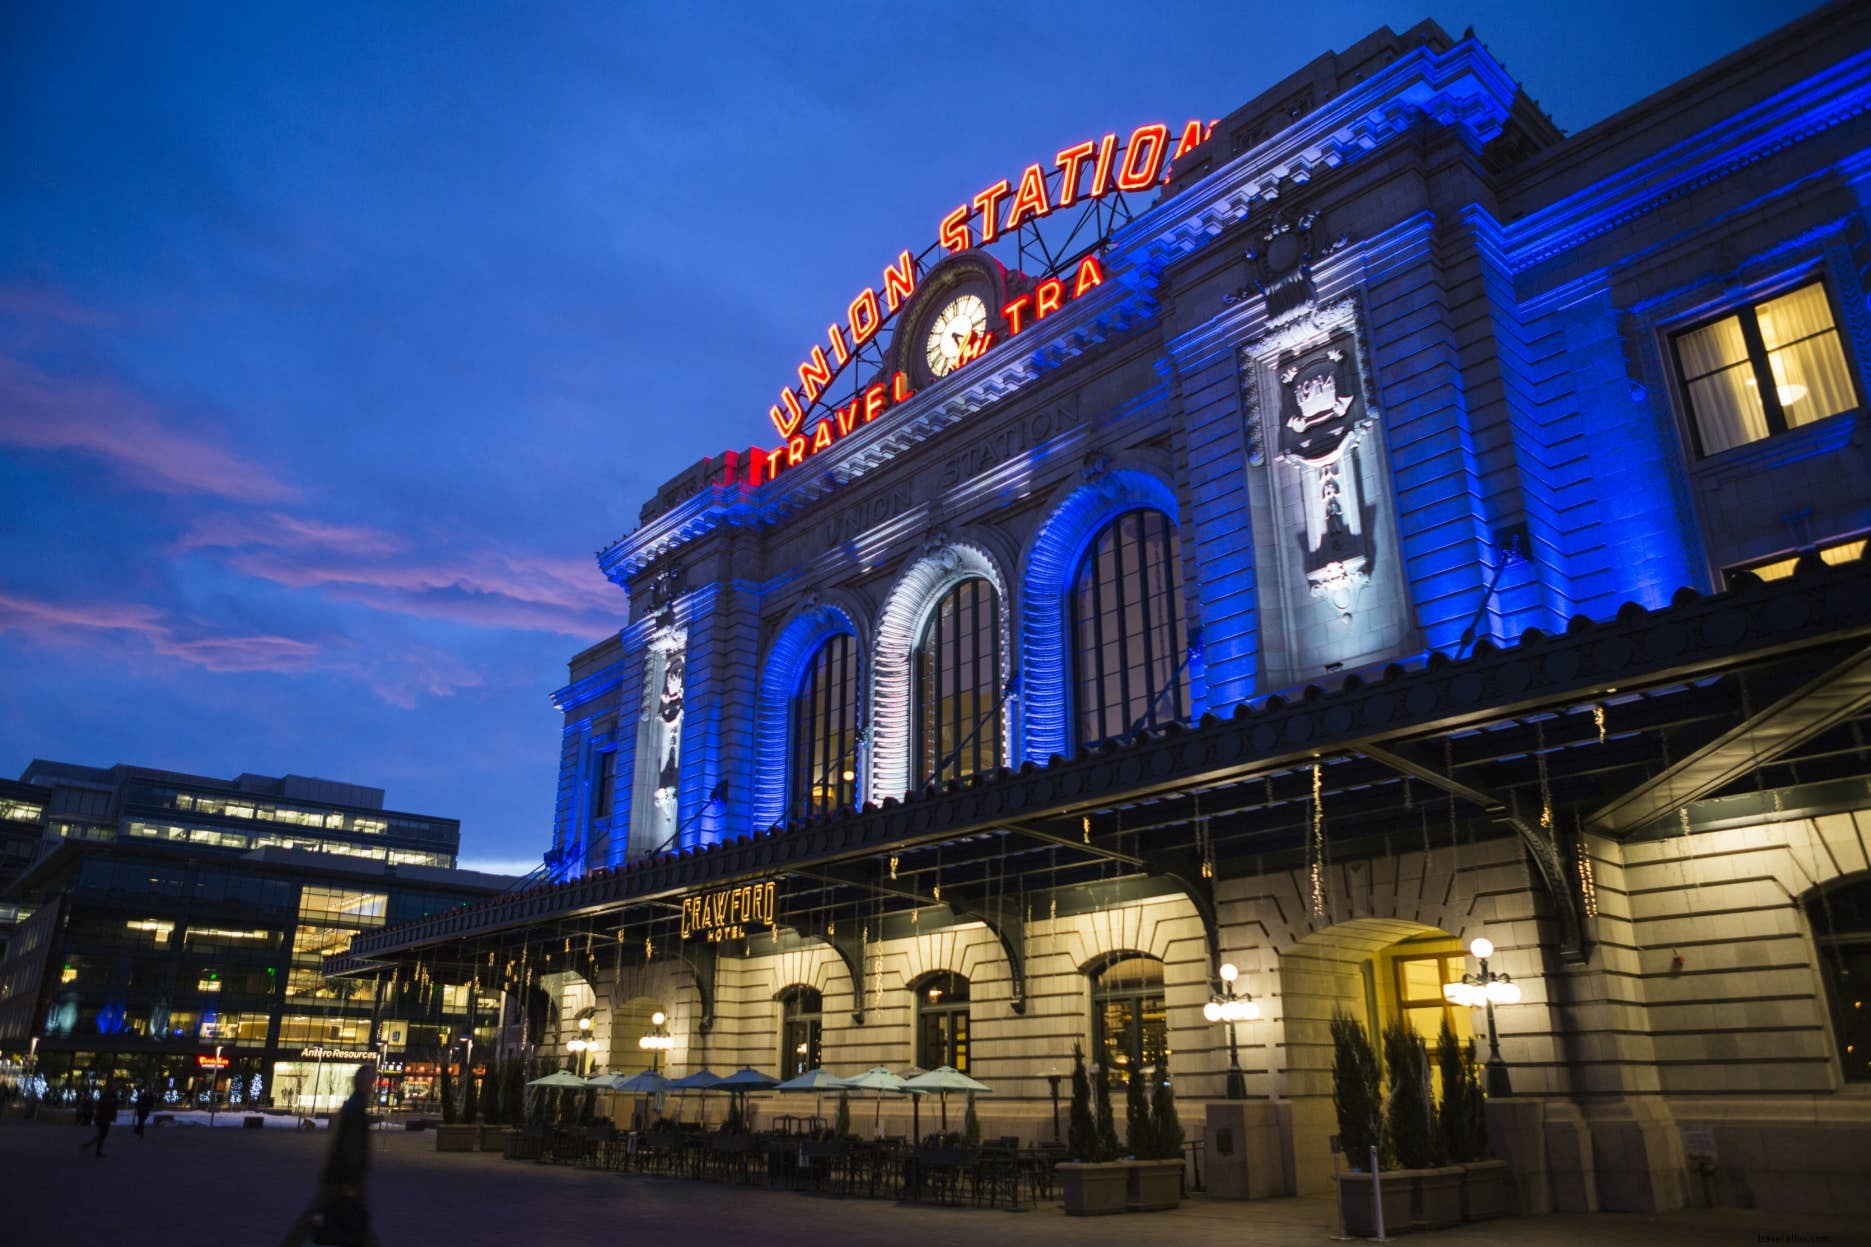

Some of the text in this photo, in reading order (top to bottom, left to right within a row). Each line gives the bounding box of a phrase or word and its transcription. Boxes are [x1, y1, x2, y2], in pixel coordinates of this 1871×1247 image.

[768, 249, 915, 440] UNION
[766, 371, 914, 481] TRAVEL
[825, 391, 1081, 546] UNION STATION
[681, 881, 775, 939] CRAWFORD
[707, 925, 745, 943] HOTEL
[332, 1048, 378, 1060] Resources
